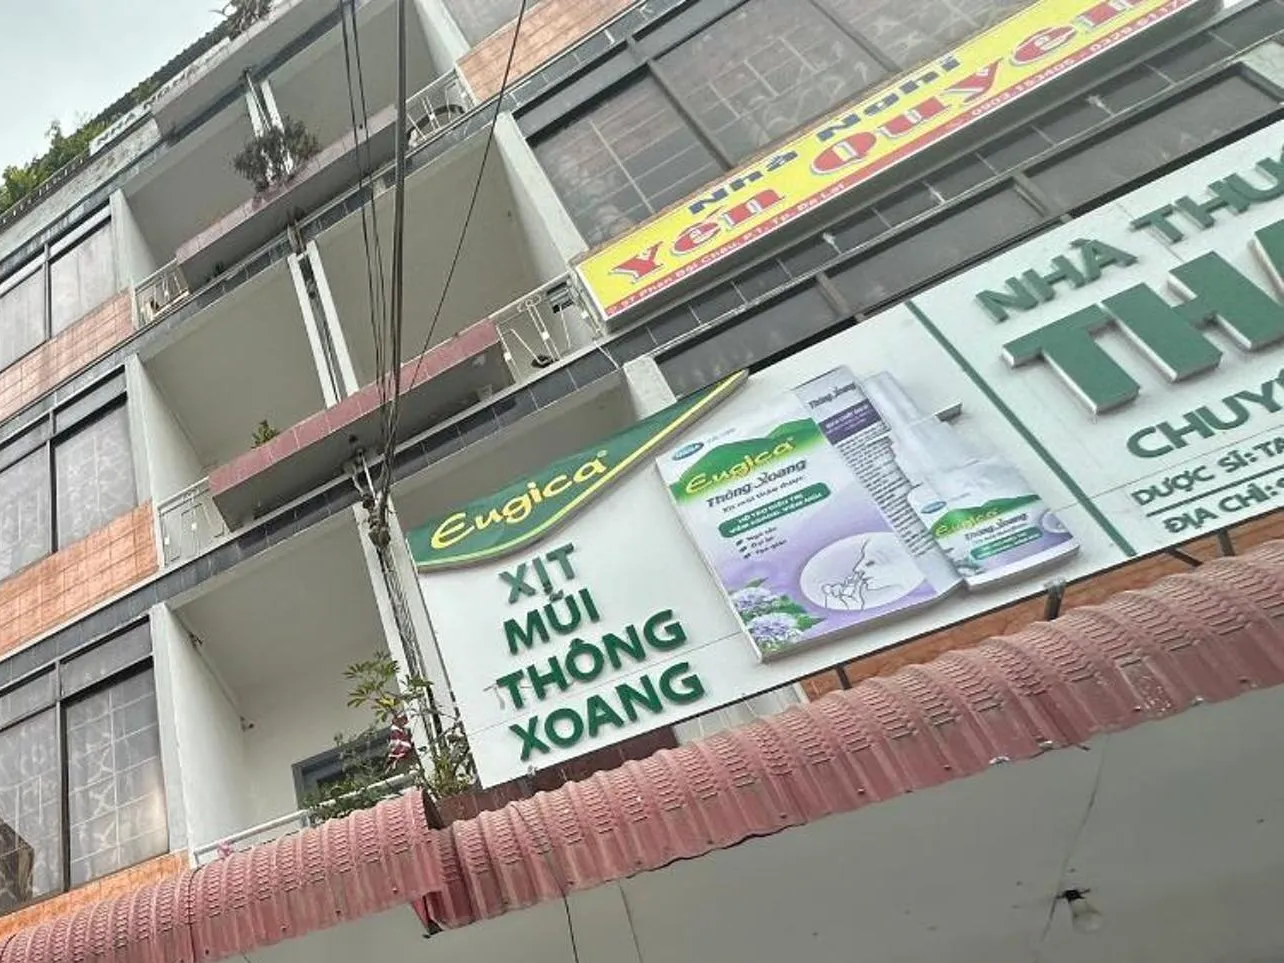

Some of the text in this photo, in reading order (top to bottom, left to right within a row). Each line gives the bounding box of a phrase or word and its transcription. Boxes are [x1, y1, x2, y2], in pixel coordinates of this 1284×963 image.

[975, 146, 1284, 323] NHÀ THU
[1126, 369, 1284, 458] CHUY
[431, 454, 609, 549] Eugica
[685, 438, 797, 495] Eugica
[1130, 464, 1216, 506] DƯỢC
[1162, 507, 1219, 534] ĐỊA
[498, 542, 575, 605] XỊT
[495, 609, 688, 710] THÔNG
[503, 587, 601, 656] MŨI
[509, 661, 706, 762] XOANG
